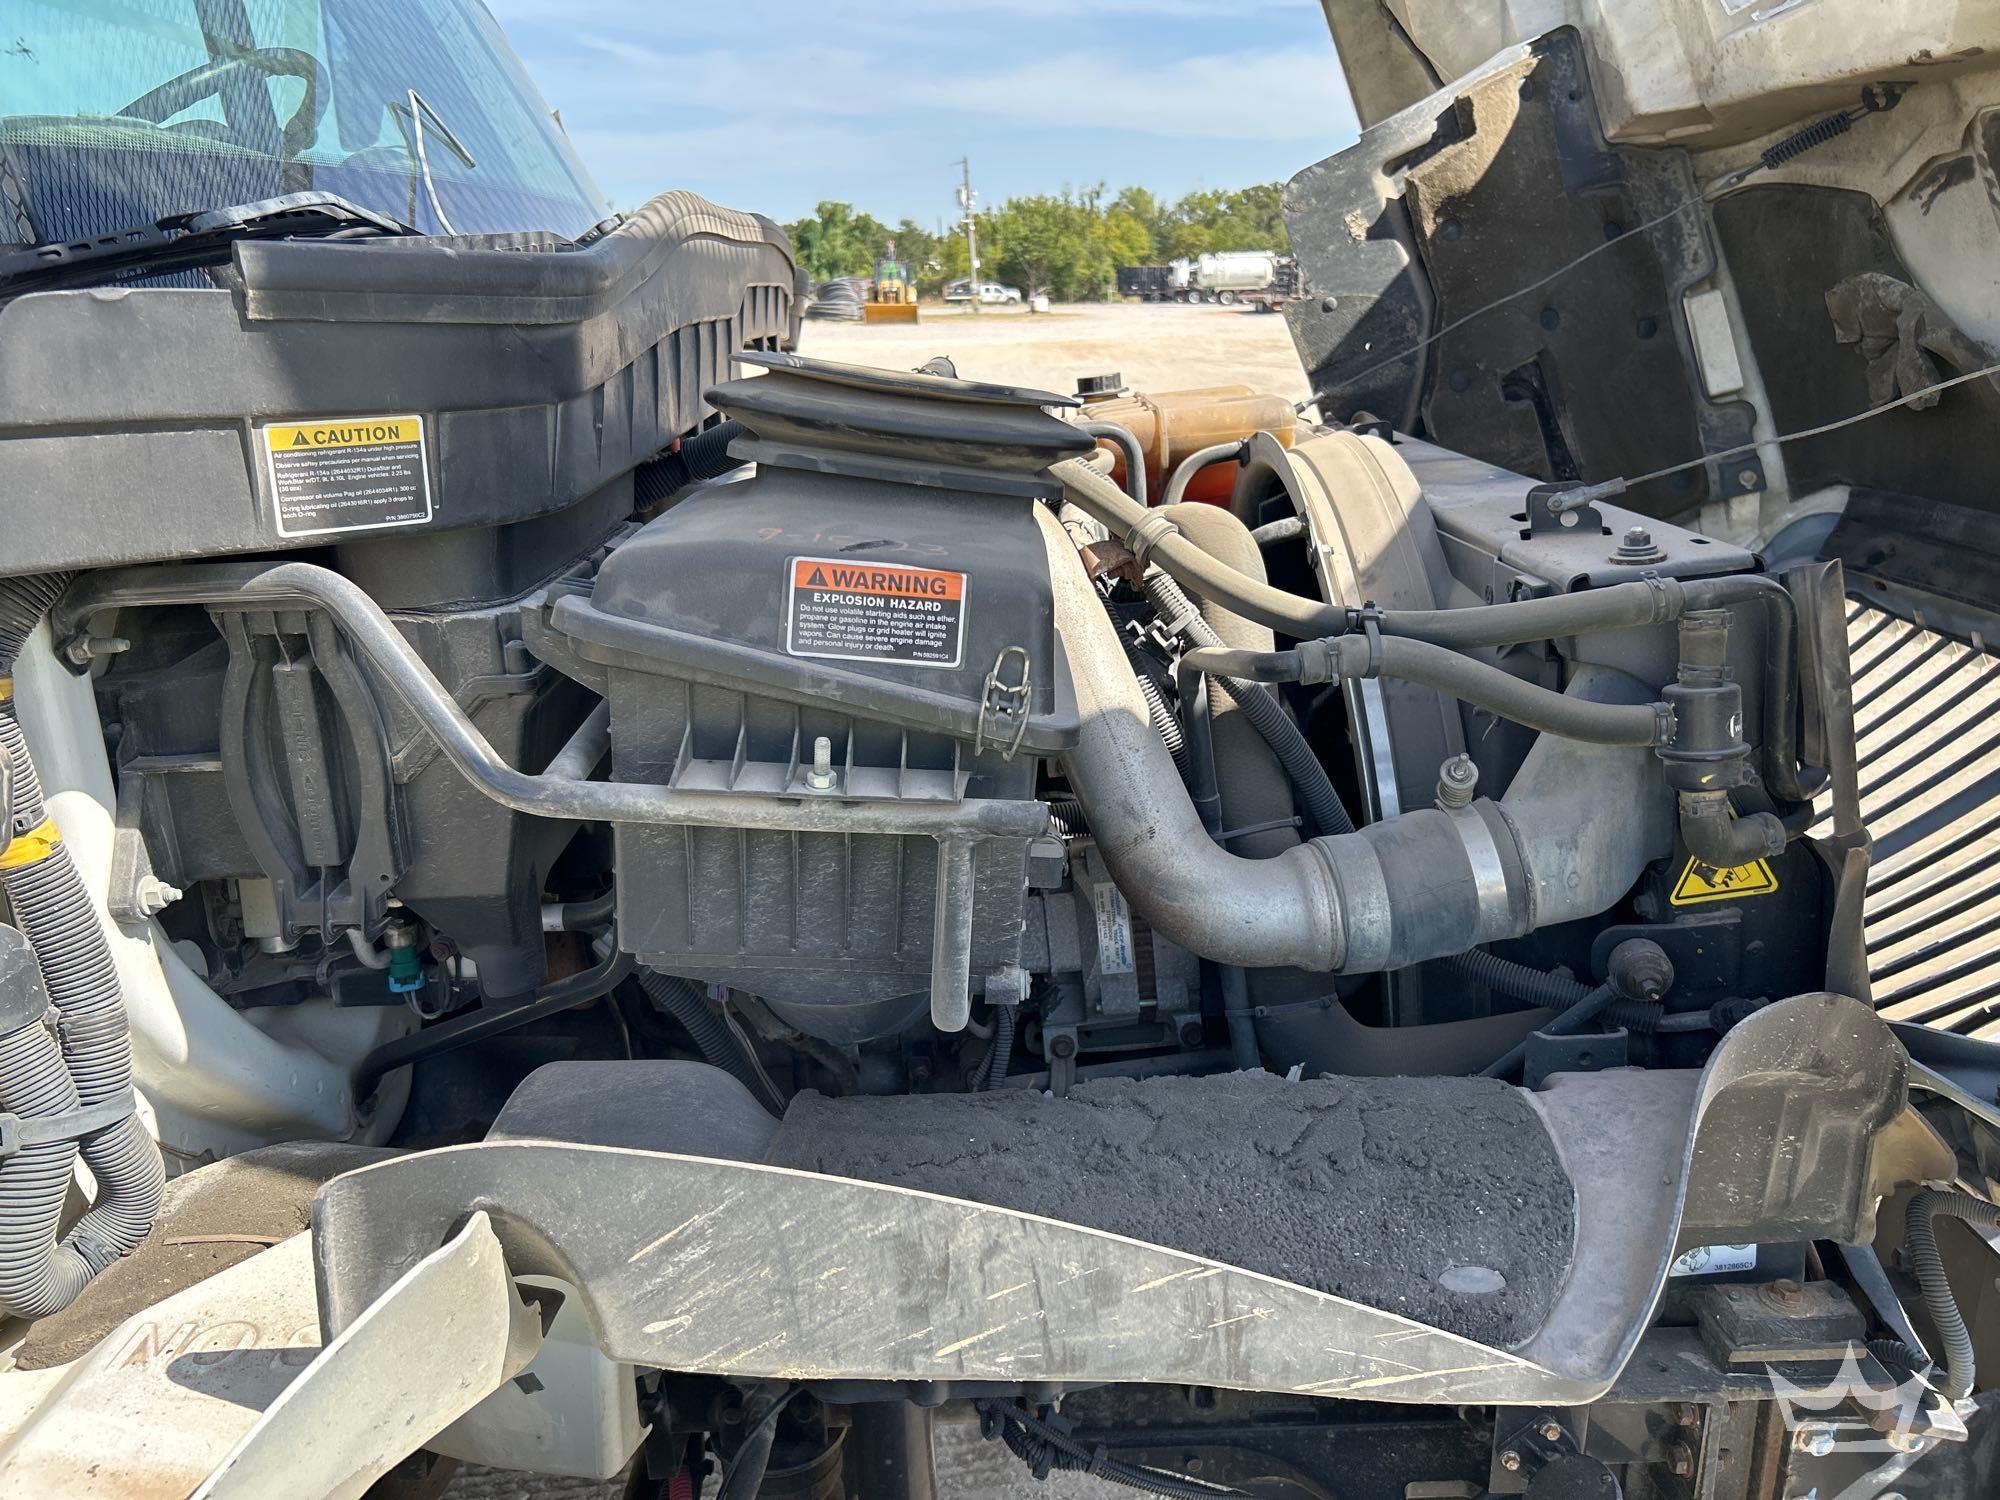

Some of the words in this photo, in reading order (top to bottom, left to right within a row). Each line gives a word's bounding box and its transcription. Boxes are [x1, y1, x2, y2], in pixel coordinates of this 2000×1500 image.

[313, 425, 400, 445] CAUTION
[283, 450, 317, 458] conditioning
[319, 458, 351, 466] precautions
[277, 478, 304, 486] WorkStar
[832, 568, 947, 595] WARNING
[813, 592, 885, 607] EXPLOSION
[890, 598, 942, 612] HAZARD
[800, 603, 811, 611] Do
[812, 605, 824, 613] not
[839, 607, 864, 616] volatile
[865, 609, 892, 619] starting
[892, 611, 907, 620] aids
[799, 613, 829, 621] propane
[839, 616, 868, 624] gasoline
[869, 617, 876, 625] in
[877, 618, 889, 626] the
[890, 620, 914, 628] engine
[925, 622, 947, 631] intake
[827, 622, 846, 631] Glow
[847, 624, 866, 633] plugs
[876, 627, 890, 635] grid
[891, 628, 914, 636] heater
[927, 631, 947, 639] ignite
[813, 639, 844, 647] personal
[844, 641, 864, 650] injury
[865, 635, 889, 643] severe
[889, 637, 914, 645] engine
[914, 638, 943, 648] damage
[104, 1321, 259, 1371] NO
